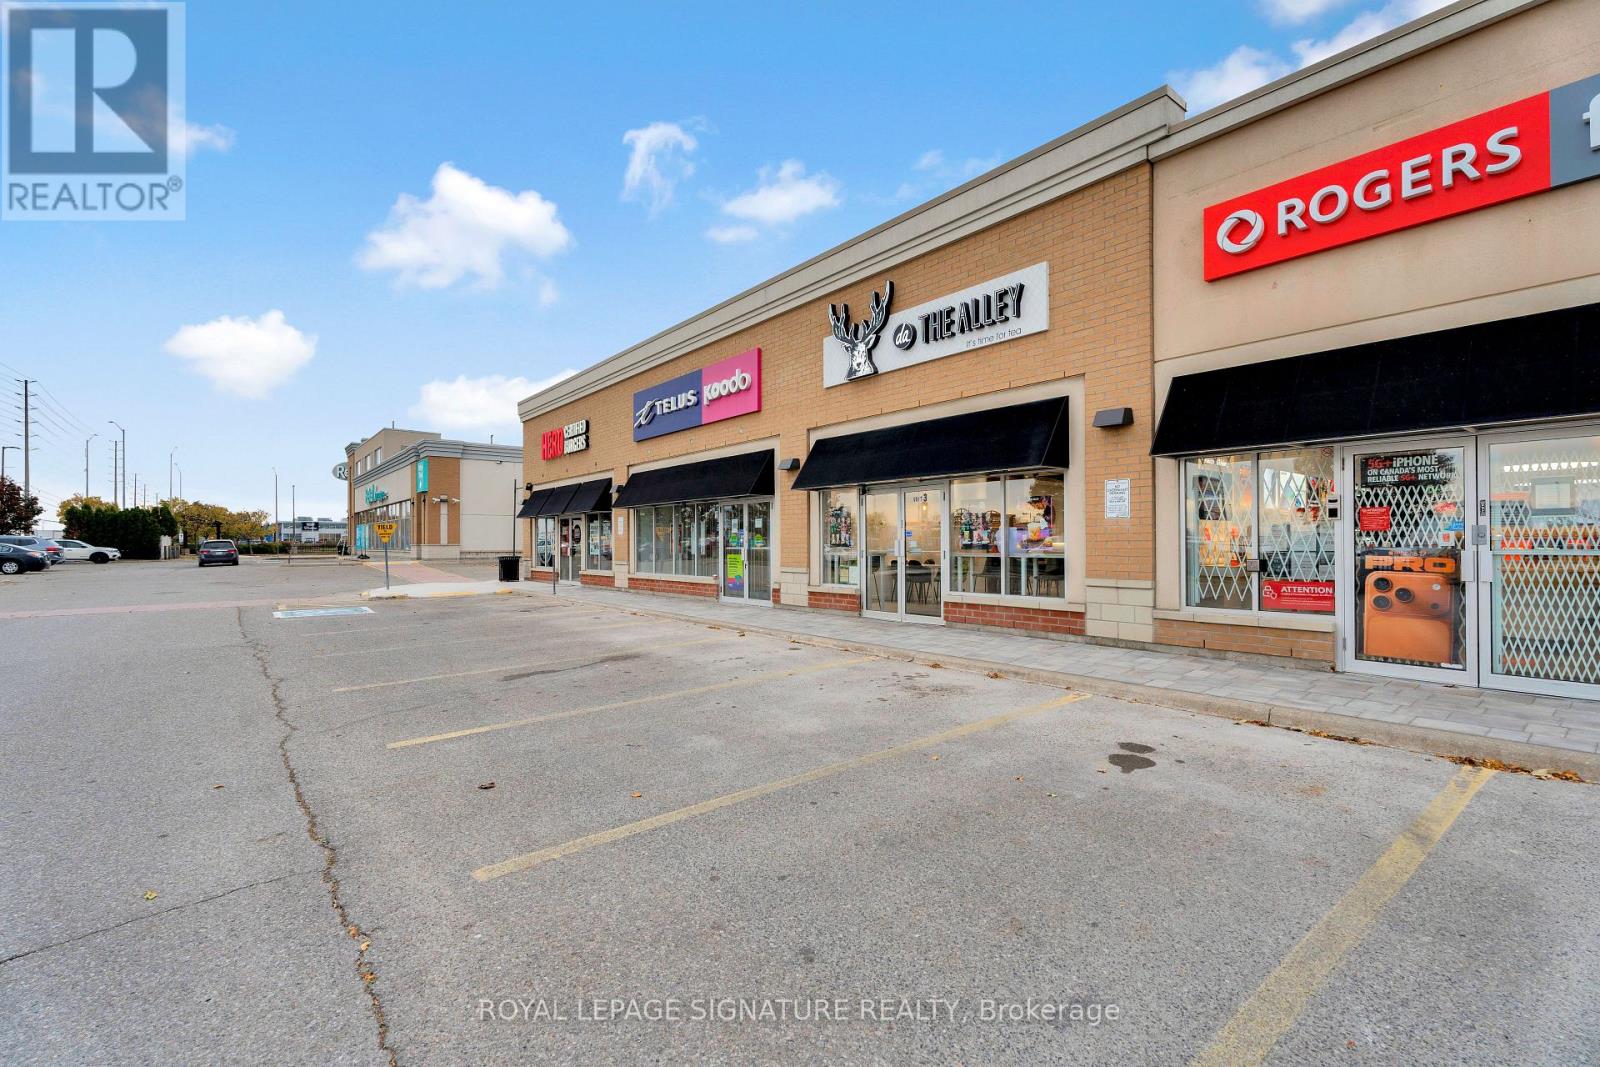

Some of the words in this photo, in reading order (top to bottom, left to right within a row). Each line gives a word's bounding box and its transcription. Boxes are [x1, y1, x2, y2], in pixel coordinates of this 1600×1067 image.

[1277, 126, 1522, 237] ROGERS
[917, 305, 955, 344] THE
[957, 282, 1025, 334] ALLEY
[978, 335, 993, 346] time
[996, 332, 1006, 341] for
[1008, 327, 1022, 337] tea
[654, 389, 698, 415] TELUS
[541, 426, 564, 461] HERO
[1379, 467, 1415, 475] CANADA'S
[1417, 465, 1438, 474] MOST
[1392, 455, 1438, 468] iPHONE
[1367, 474, 1399, 483] RELIABLE
[1418, 472, 1457, 480] NETWORK
[1364, 555, 1456, 573] PRO
[1280, 586, 1333, 594] ATTENTION
